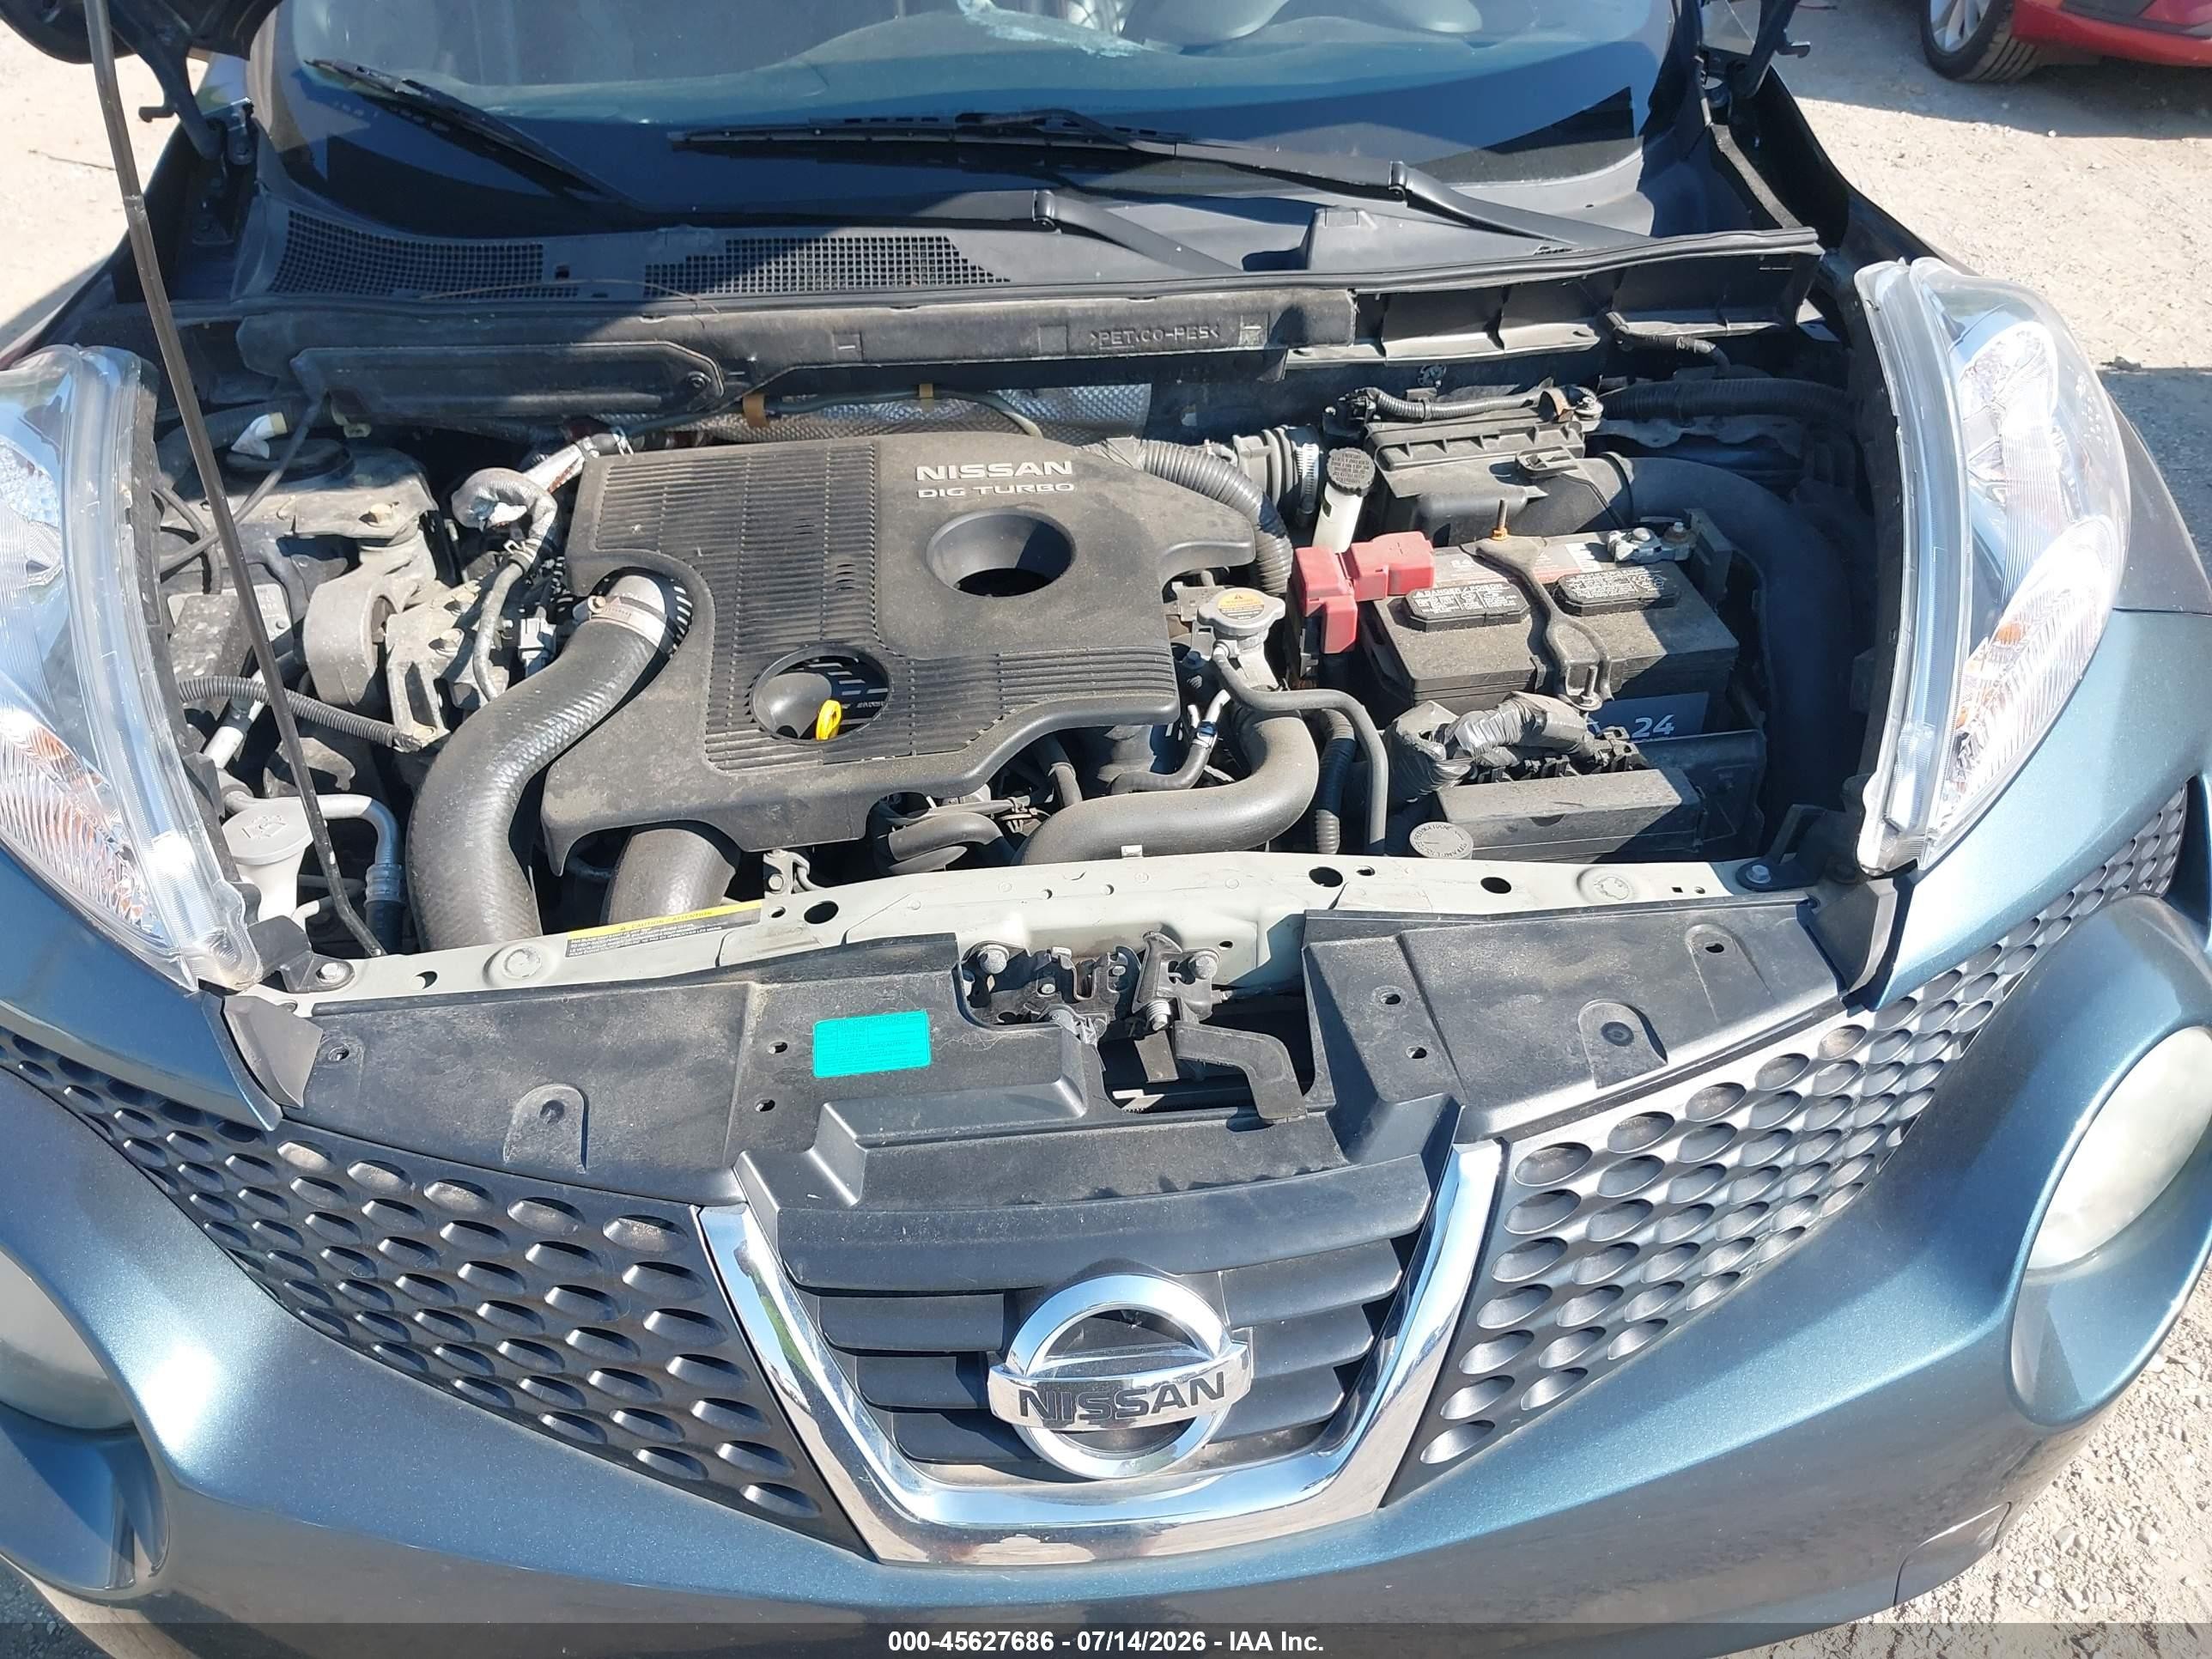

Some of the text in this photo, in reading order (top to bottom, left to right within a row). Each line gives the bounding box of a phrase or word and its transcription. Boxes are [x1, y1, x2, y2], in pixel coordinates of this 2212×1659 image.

[915, 460, 1073, 481] NISSAN
[917, 482, 1075, 499] DIG TURBO
[1632, 714, 1674, 738] 24
[1018, 1371, 1225, 1421] NISSAN
